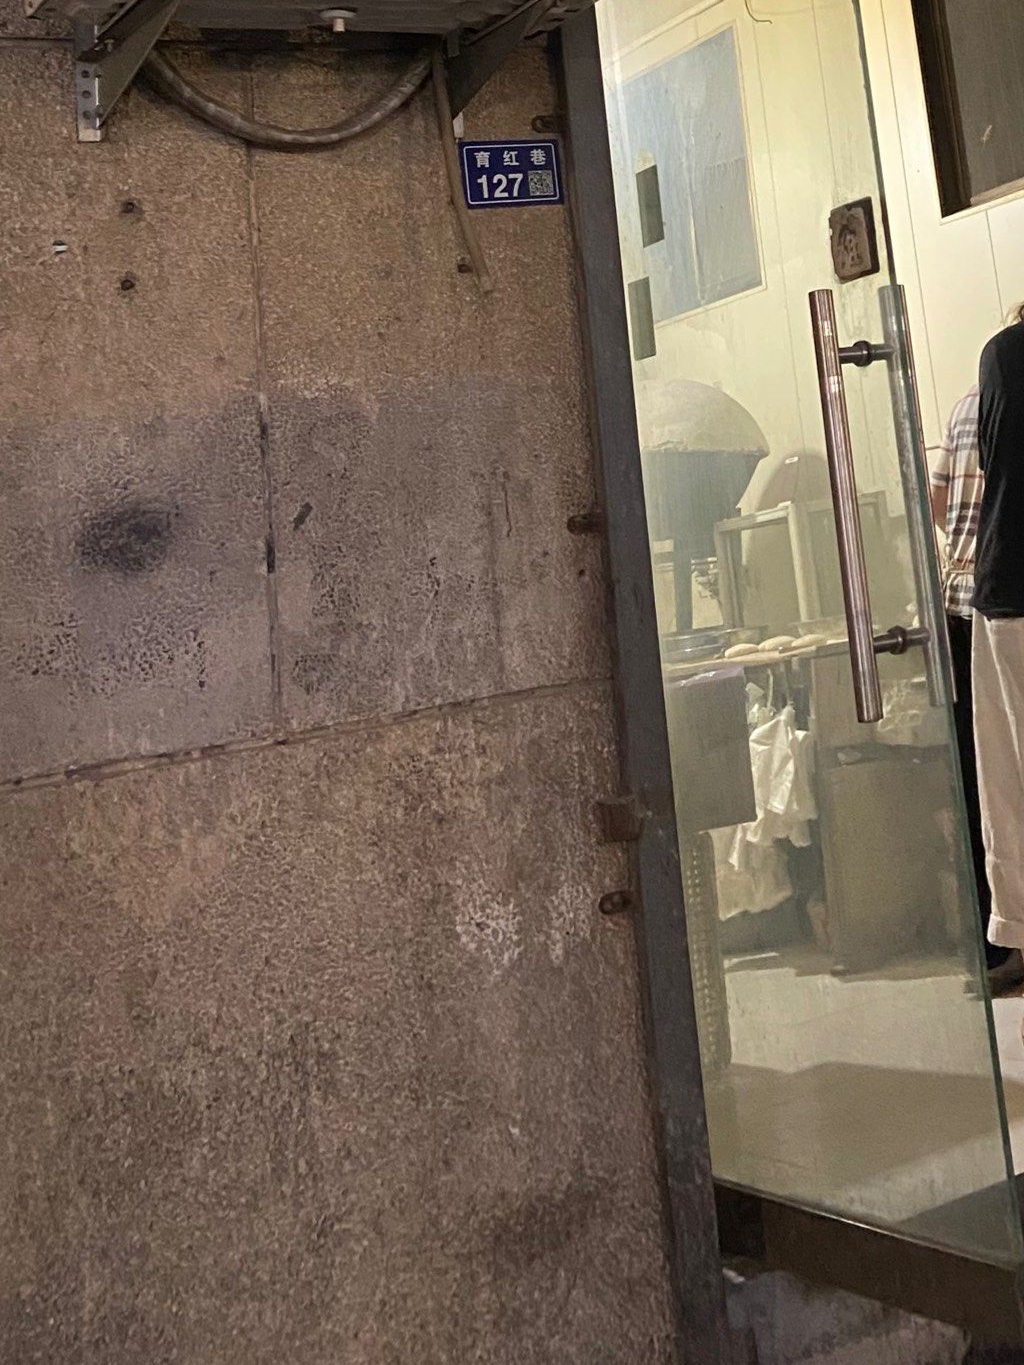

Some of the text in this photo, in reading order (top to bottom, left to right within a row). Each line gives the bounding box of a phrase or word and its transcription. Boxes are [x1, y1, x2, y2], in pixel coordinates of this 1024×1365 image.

[474, 148, 546, 168] 育红巷
[477, 173, 523, 199] 127
